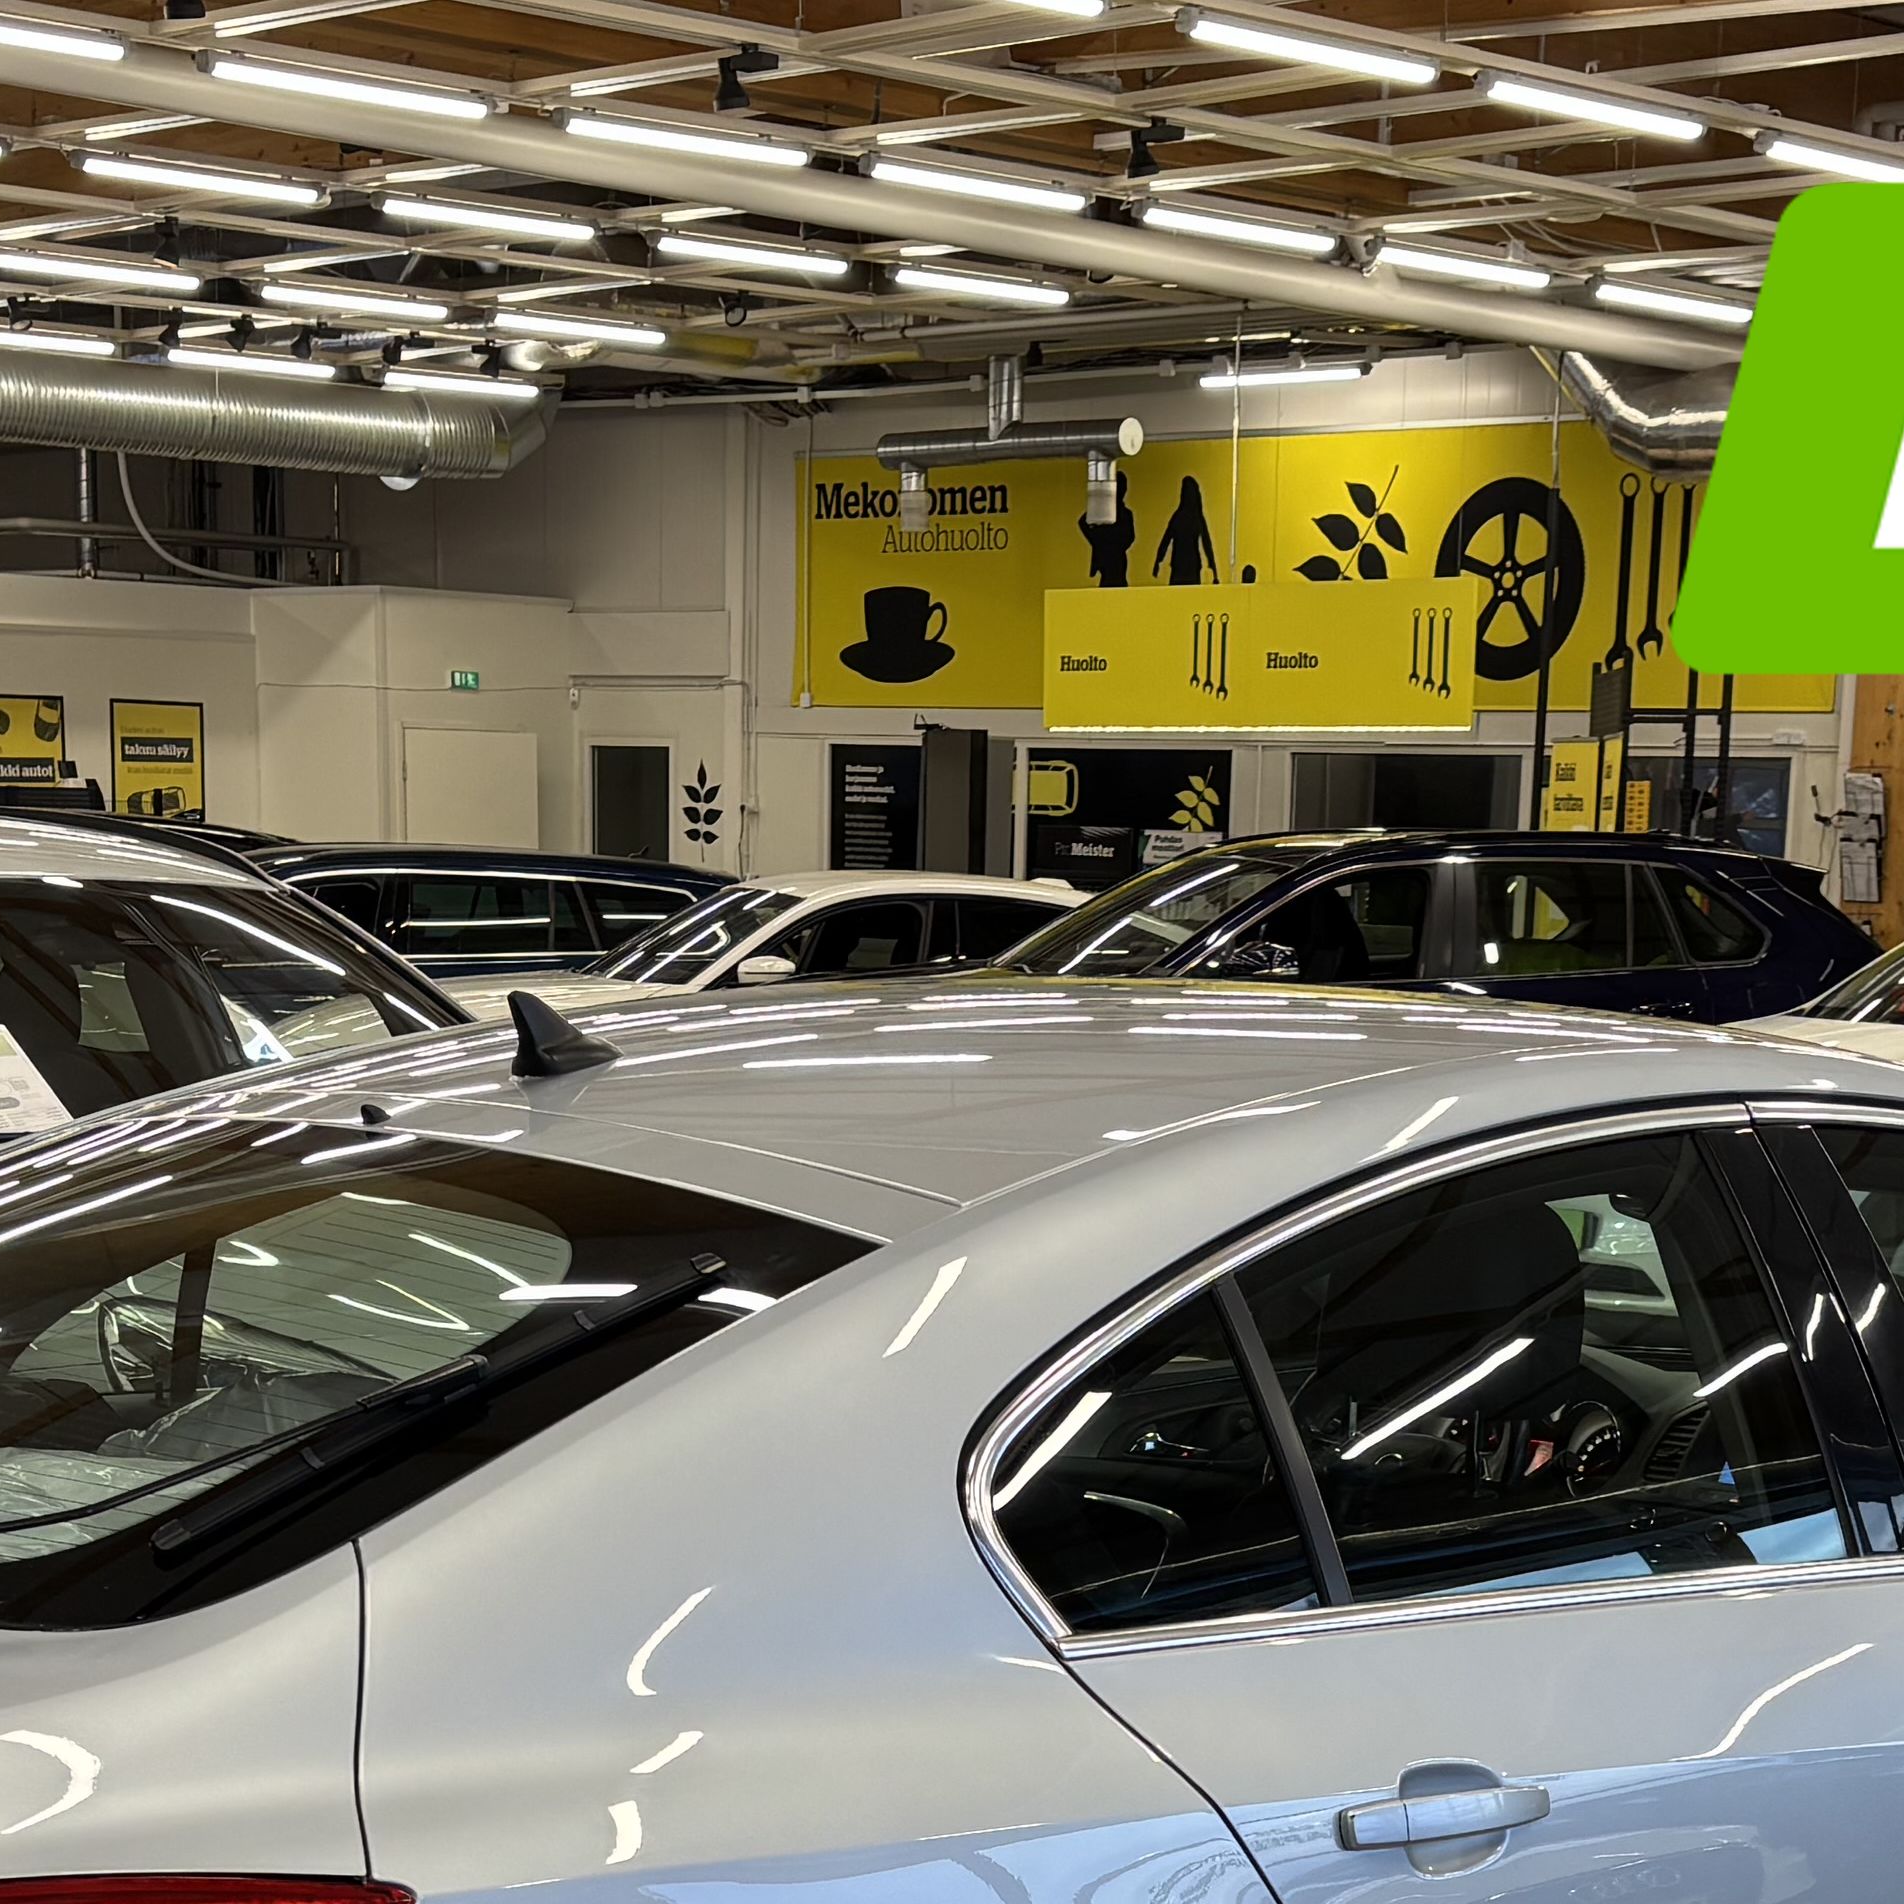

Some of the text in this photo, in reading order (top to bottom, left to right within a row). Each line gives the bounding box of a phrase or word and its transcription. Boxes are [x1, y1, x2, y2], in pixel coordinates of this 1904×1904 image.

[815, 482, 1008, 519] Mekoomen
[882, 522, 1008, 553] Autohuolto
[1060, 655, 1107, 672] Huolto
[1266, 652, 1318, 669] Huolto
[124, 743, 189, 758] takuu säilyy
[22, 765, 53, 777] autot
